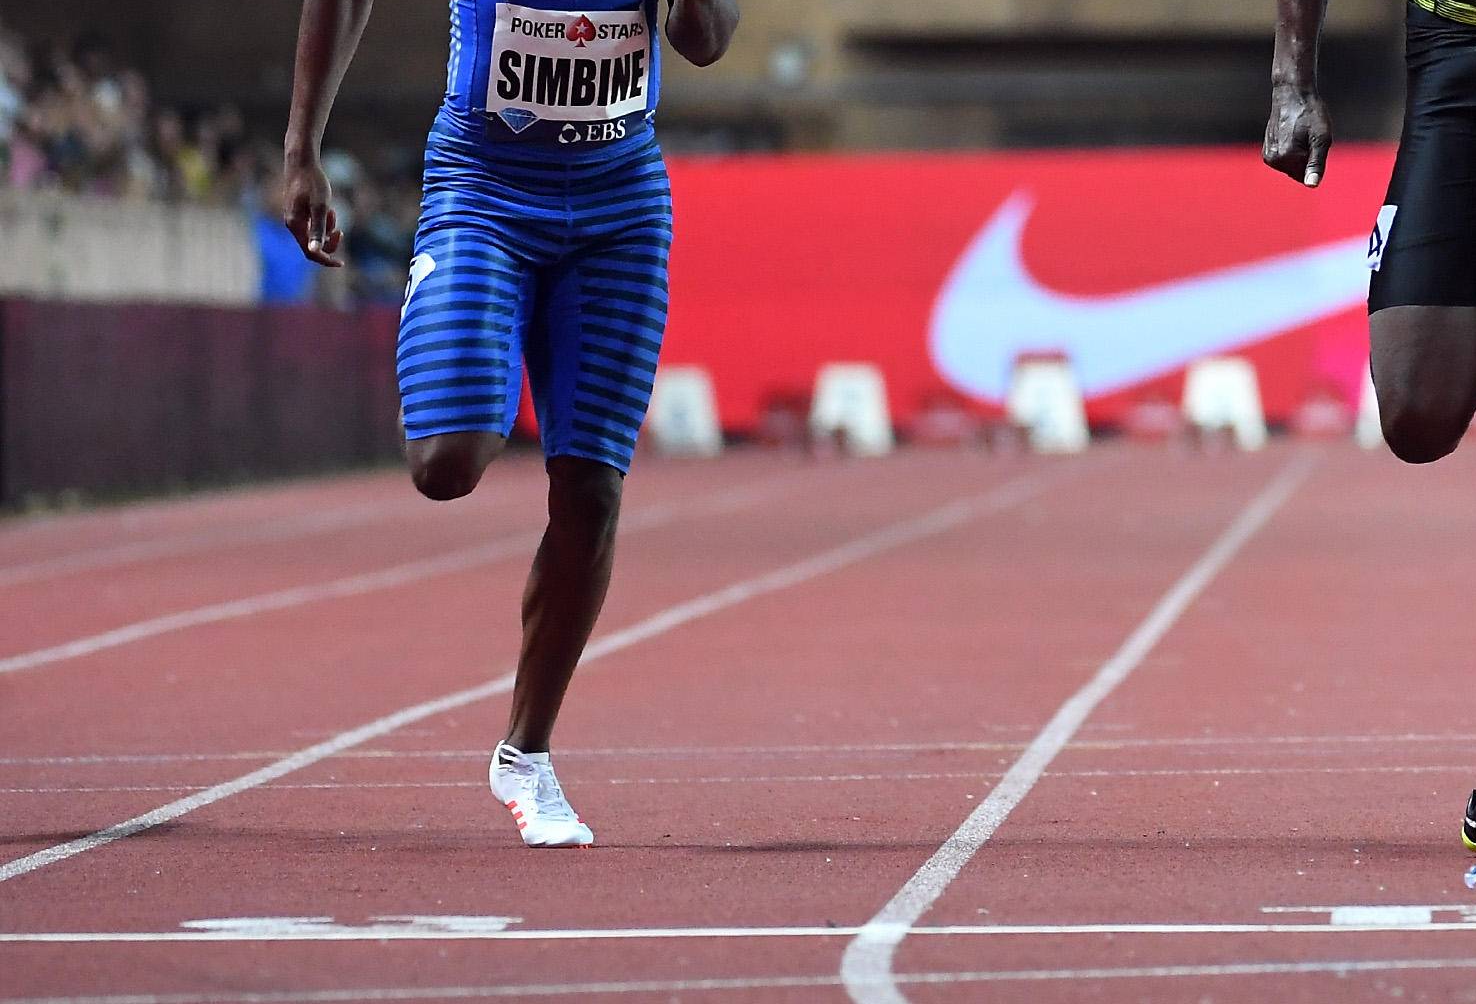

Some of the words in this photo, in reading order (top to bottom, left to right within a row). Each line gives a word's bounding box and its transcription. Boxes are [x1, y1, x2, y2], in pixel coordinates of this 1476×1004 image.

[510, 16, 566, 39] POKER
[597, 22, 644, 40] STARS
[496, 49, 646, 107] SIMBINE
[585, 119, 627, 142] EBS
